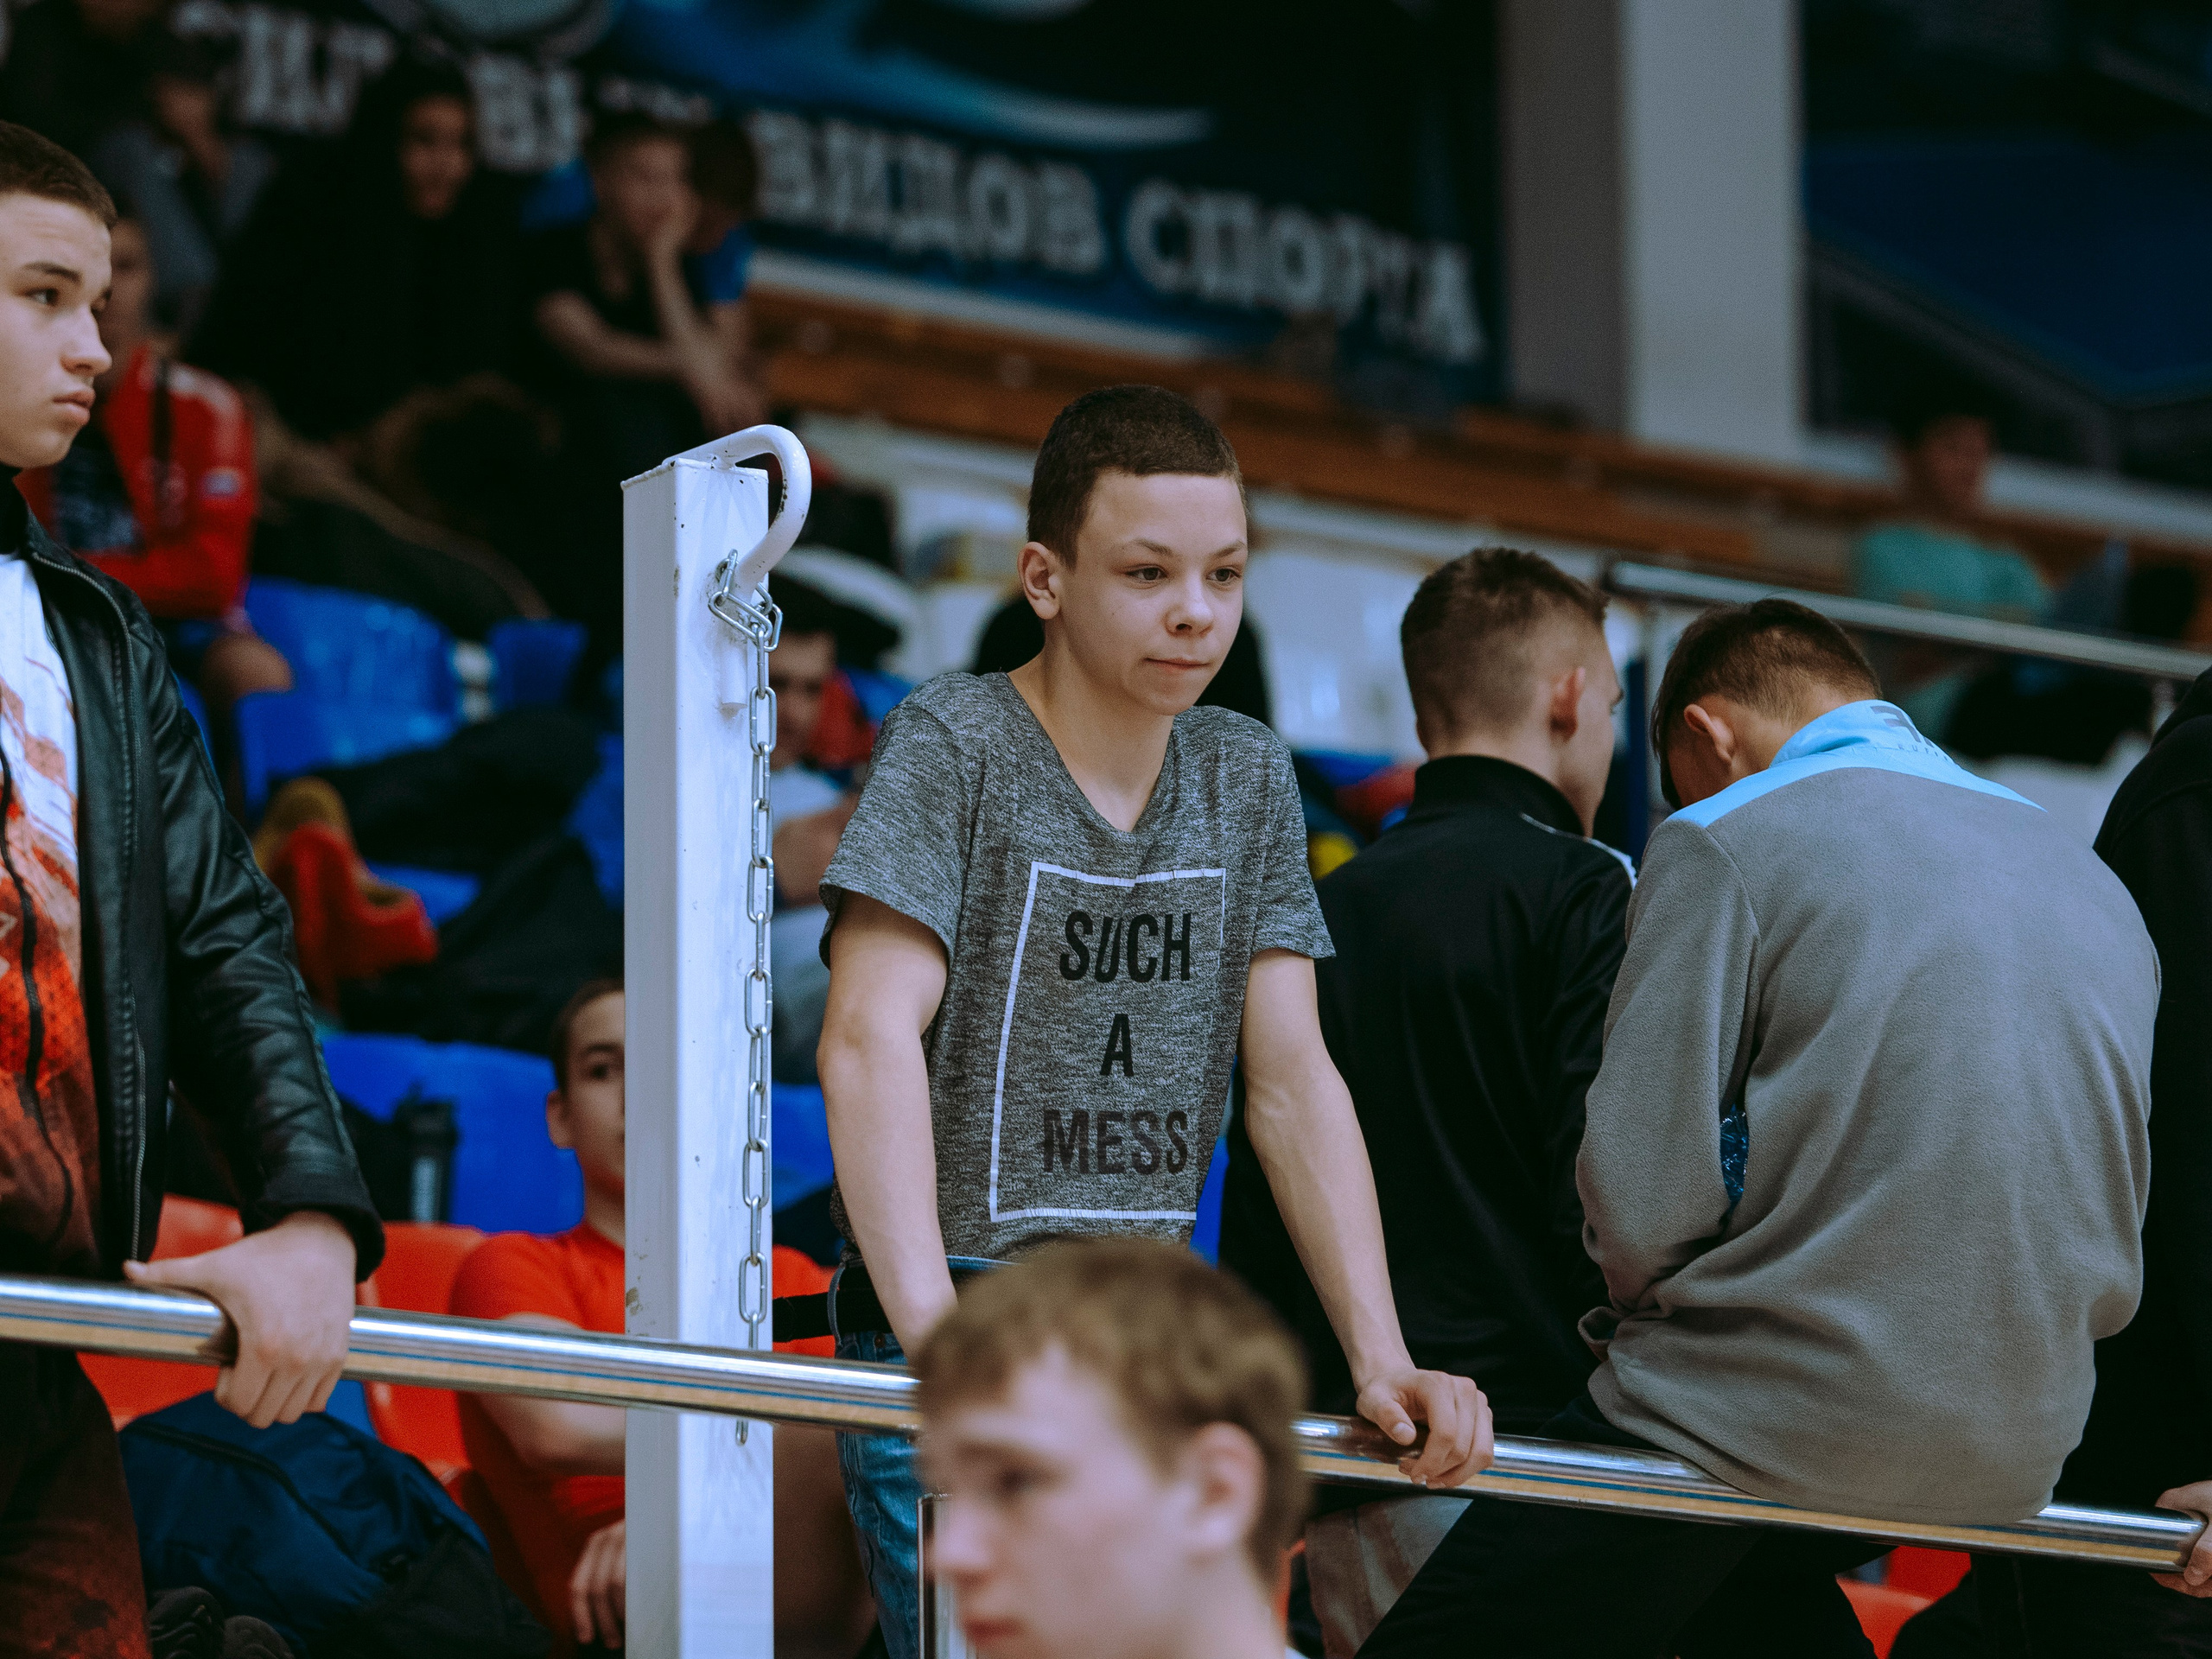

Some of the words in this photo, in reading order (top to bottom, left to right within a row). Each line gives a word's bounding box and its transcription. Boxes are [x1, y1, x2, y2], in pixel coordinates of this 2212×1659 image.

[748, 109, 1107, 275] ВИДОВ
[1124, 178, 1484, 364] СПОРТА
[1058, 911, 1192, 983] SUCH
[1099, 1014, 1135, 1077] A
[1043, 1109, 1188, 1175] MESS
